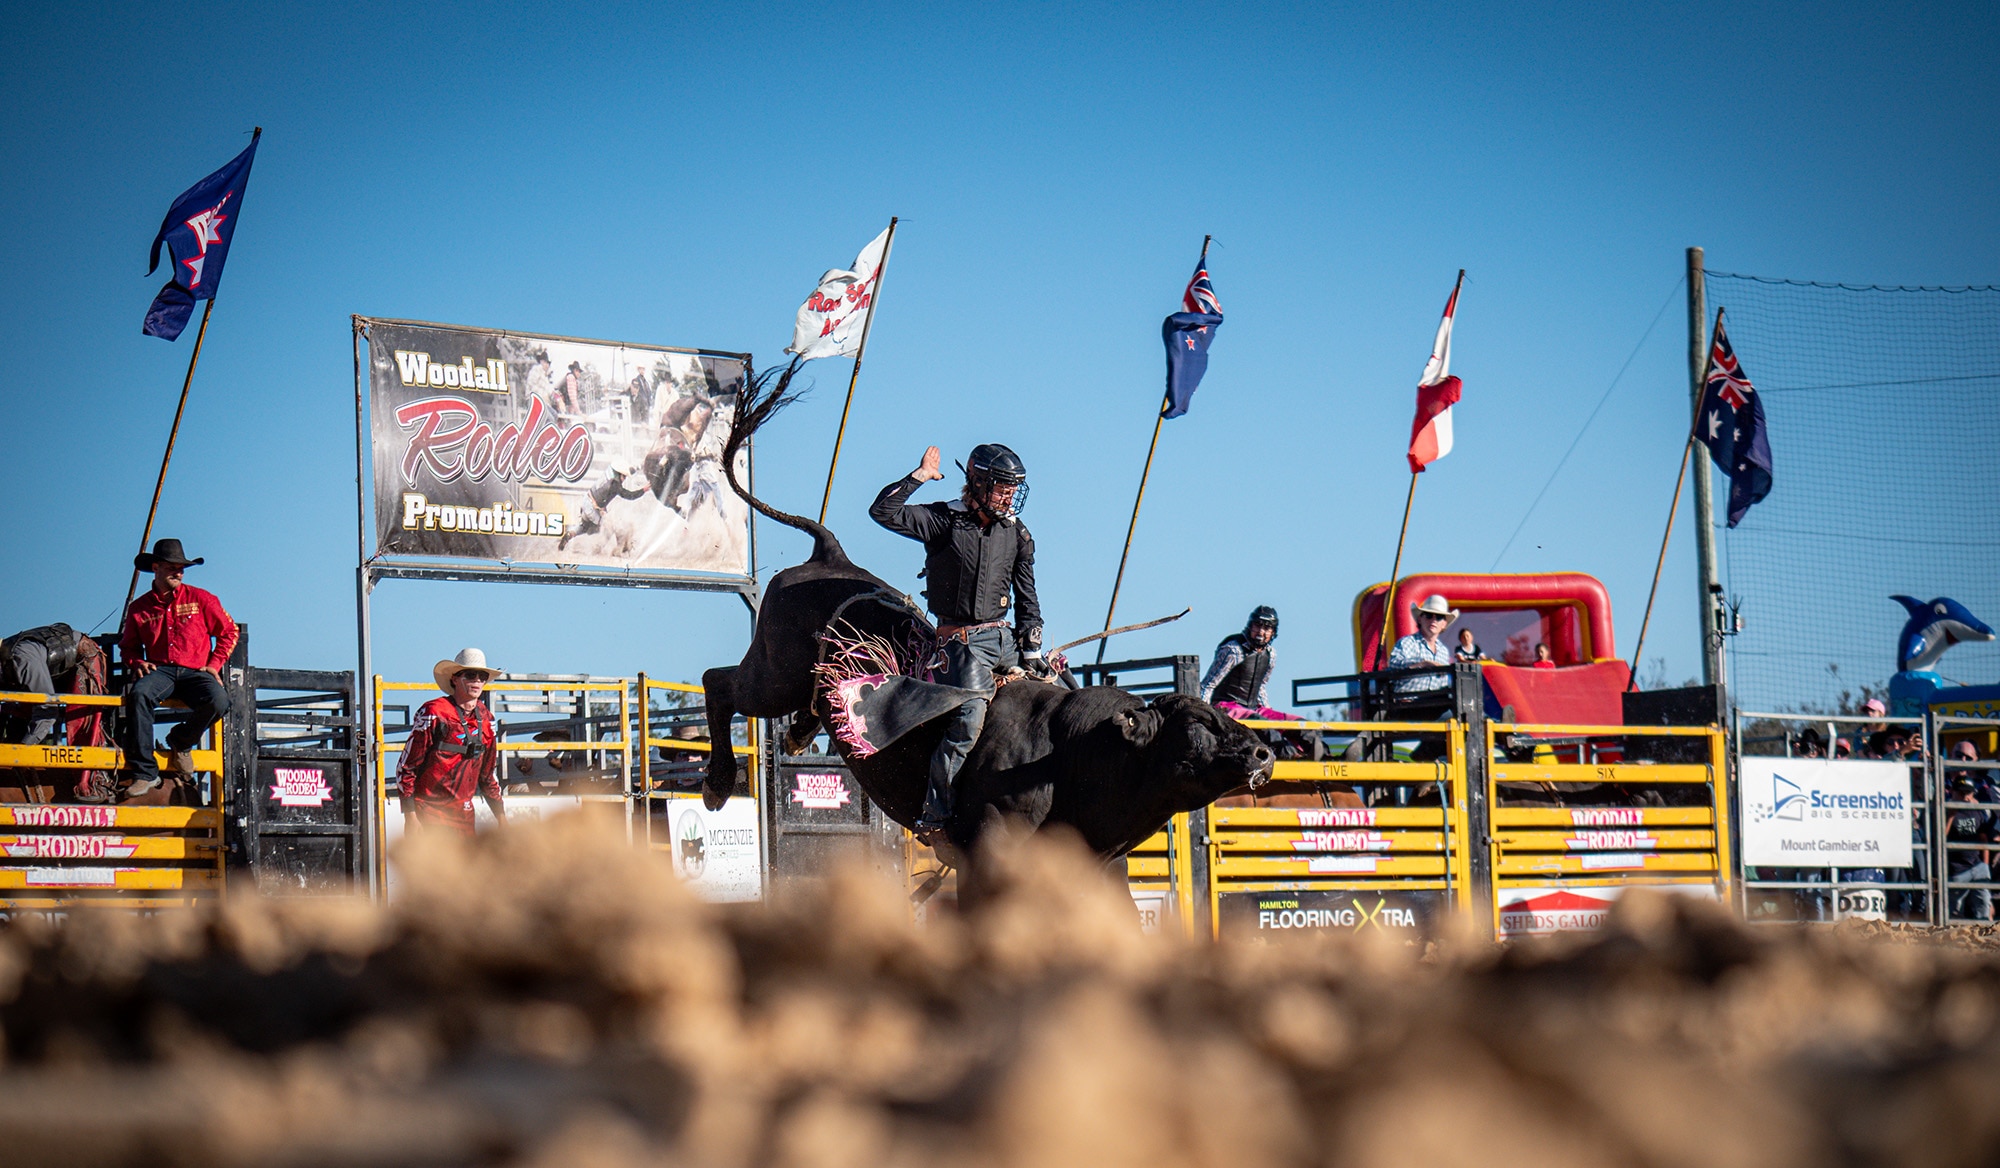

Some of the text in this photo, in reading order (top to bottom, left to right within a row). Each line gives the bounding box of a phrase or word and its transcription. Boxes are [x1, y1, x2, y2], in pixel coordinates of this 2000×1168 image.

[395, 351, 509, 393] Woodall
[395, 392, 594, 489] Rodeo
[525, 496, 533, 511] 4
[403, 494, 565, 537] Promotions
[42, 748, 83, 763] THREE
[275, 769, 326, 788] WOODALL
[1323, 765, 1348, 777] FIVE
[1597, 768, 1616, 779] SIX
[286, 782, 317, 795] RODEO
[797, 774, 845, 791] WOODALL
[807, 787, 836, 798] RODEO
[1811, 790, 1904, 810] Screenshot
[1811, 810, 1905, 820] BIG SCREENS
[709, 829, 754, 846] MCKENZIE
[1316, 832, 1368, 851] RODEO
[1587, 831, 1636, 849] RODEO
[1781, 839, 1880, 852] Mount Gambier SA
[37, 835, 105, 858] RODEO
[1259, 900, 1298, 910] HAMILTON
[1259, 909, 1355, 929] FLOORING
[1503, 914, 1555, 930] SHEDS
